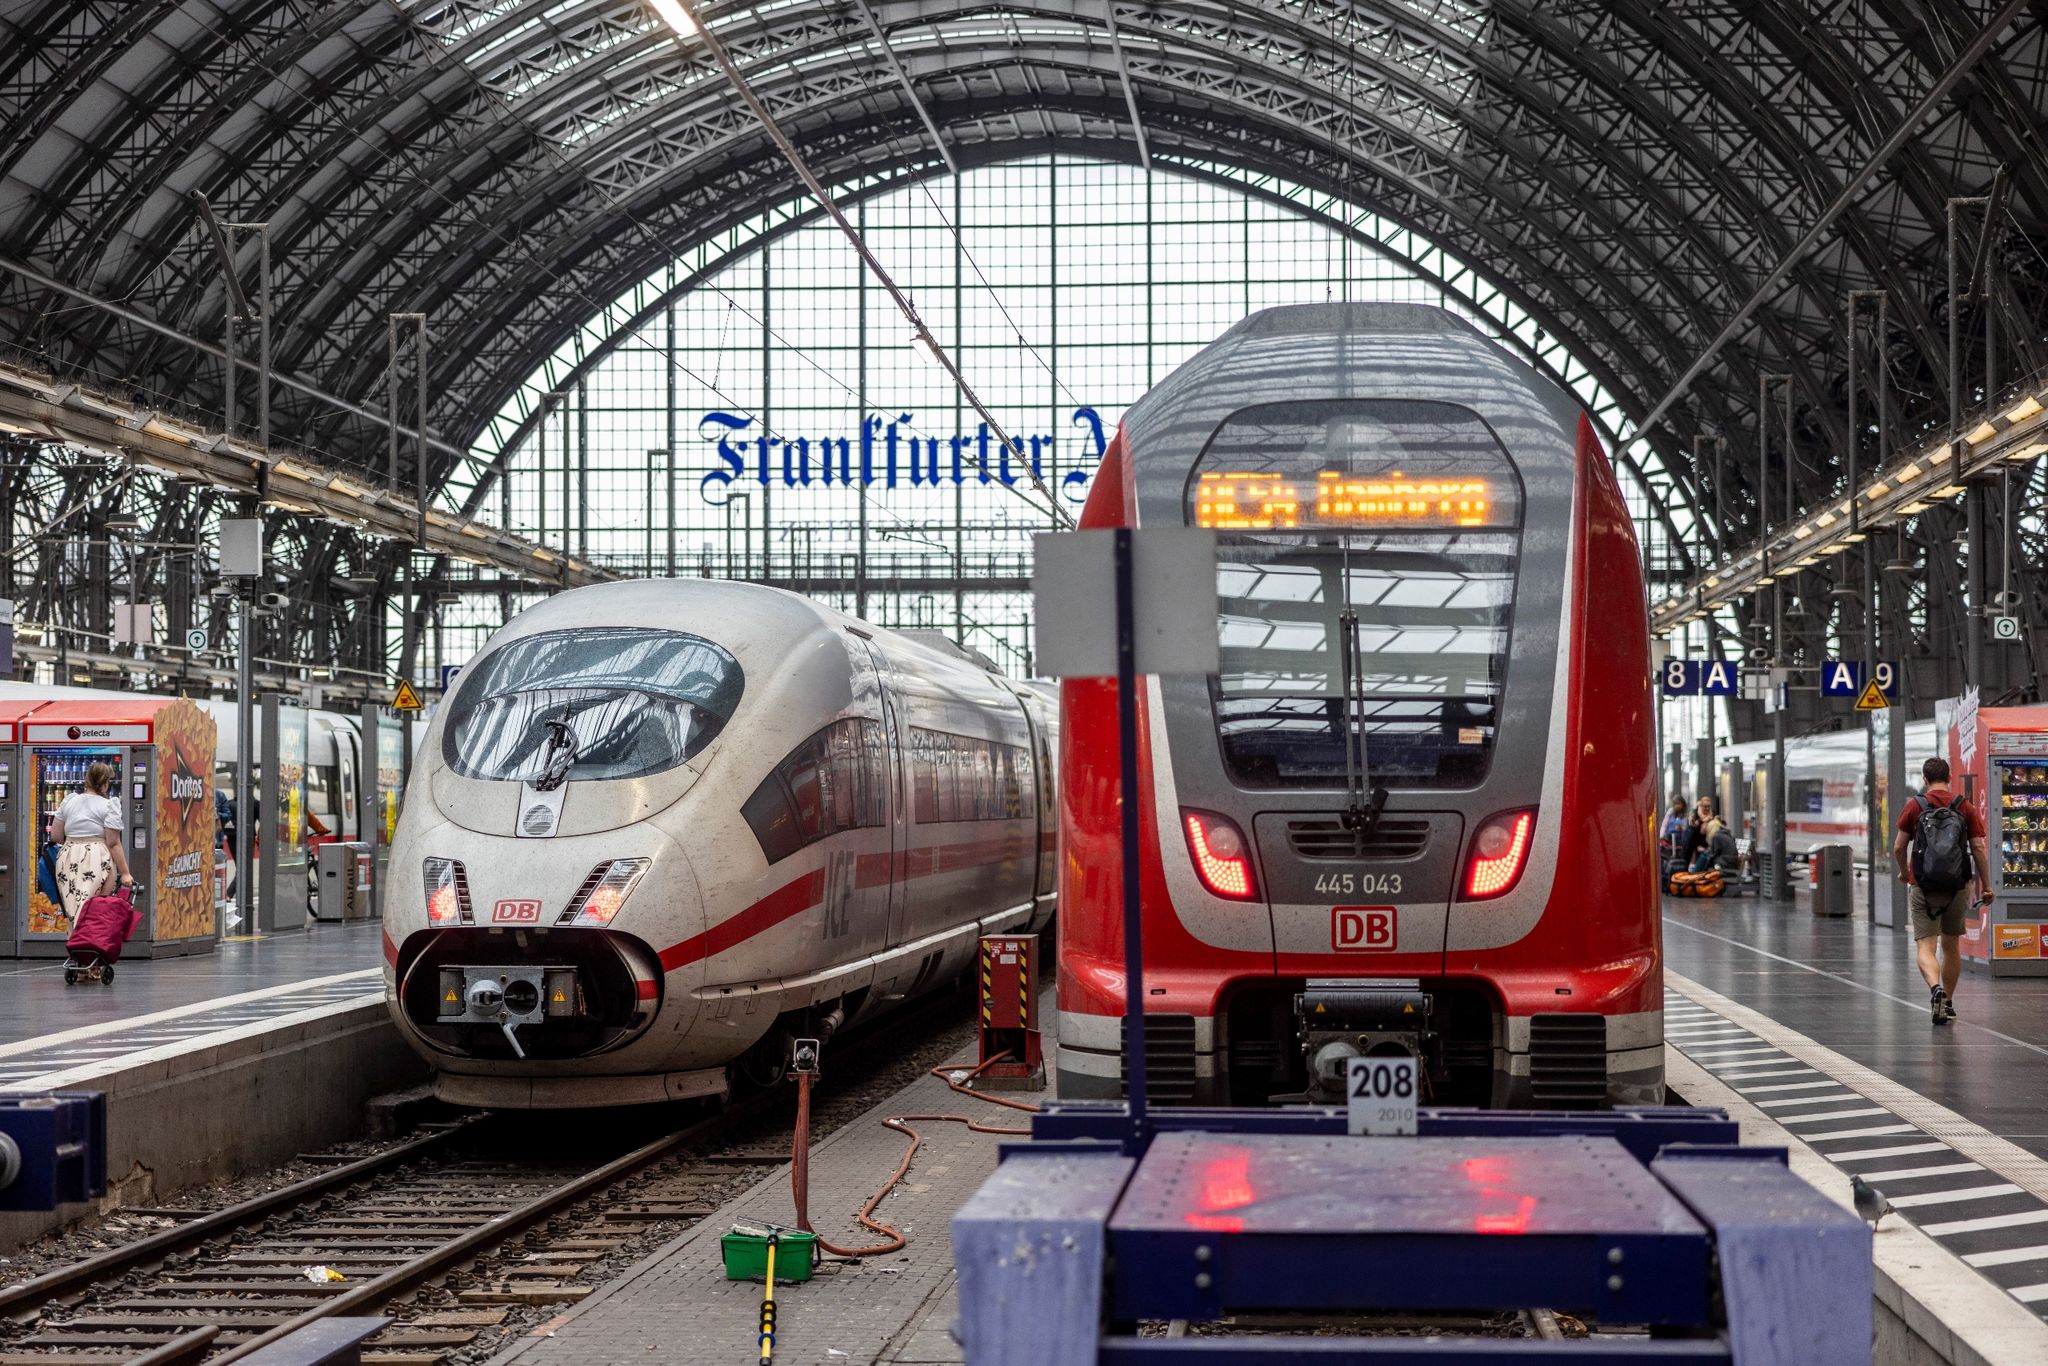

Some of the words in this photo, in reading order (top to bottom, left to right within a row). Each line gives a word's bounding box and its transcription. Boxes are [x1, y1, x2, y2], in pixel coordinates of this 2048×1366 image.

[698, 411, 1053, 505] Frankfurter
[1667, 661, 1686, 689] 8
[1706, 661, 1730, 689] A
[1830, 662, 1854, 690] A
[1875, 662, 1893, 690] 9
[82, 727, 111, 737] selecta
[171, 773, 203, 799] Doritos
[346, 868, 355, 911] Abfall
[822, 850, 855, 940] ICE
[1314, 873, 1355, 895] 445
[1362, 873, 1403, 895] 043
[497, 902, 536, 920] DB
[1338, 912, 1392, 946] DB
[1351, 1064, 1413, 1098] 208
[1378, 1108, 1413, 1121] 2010
